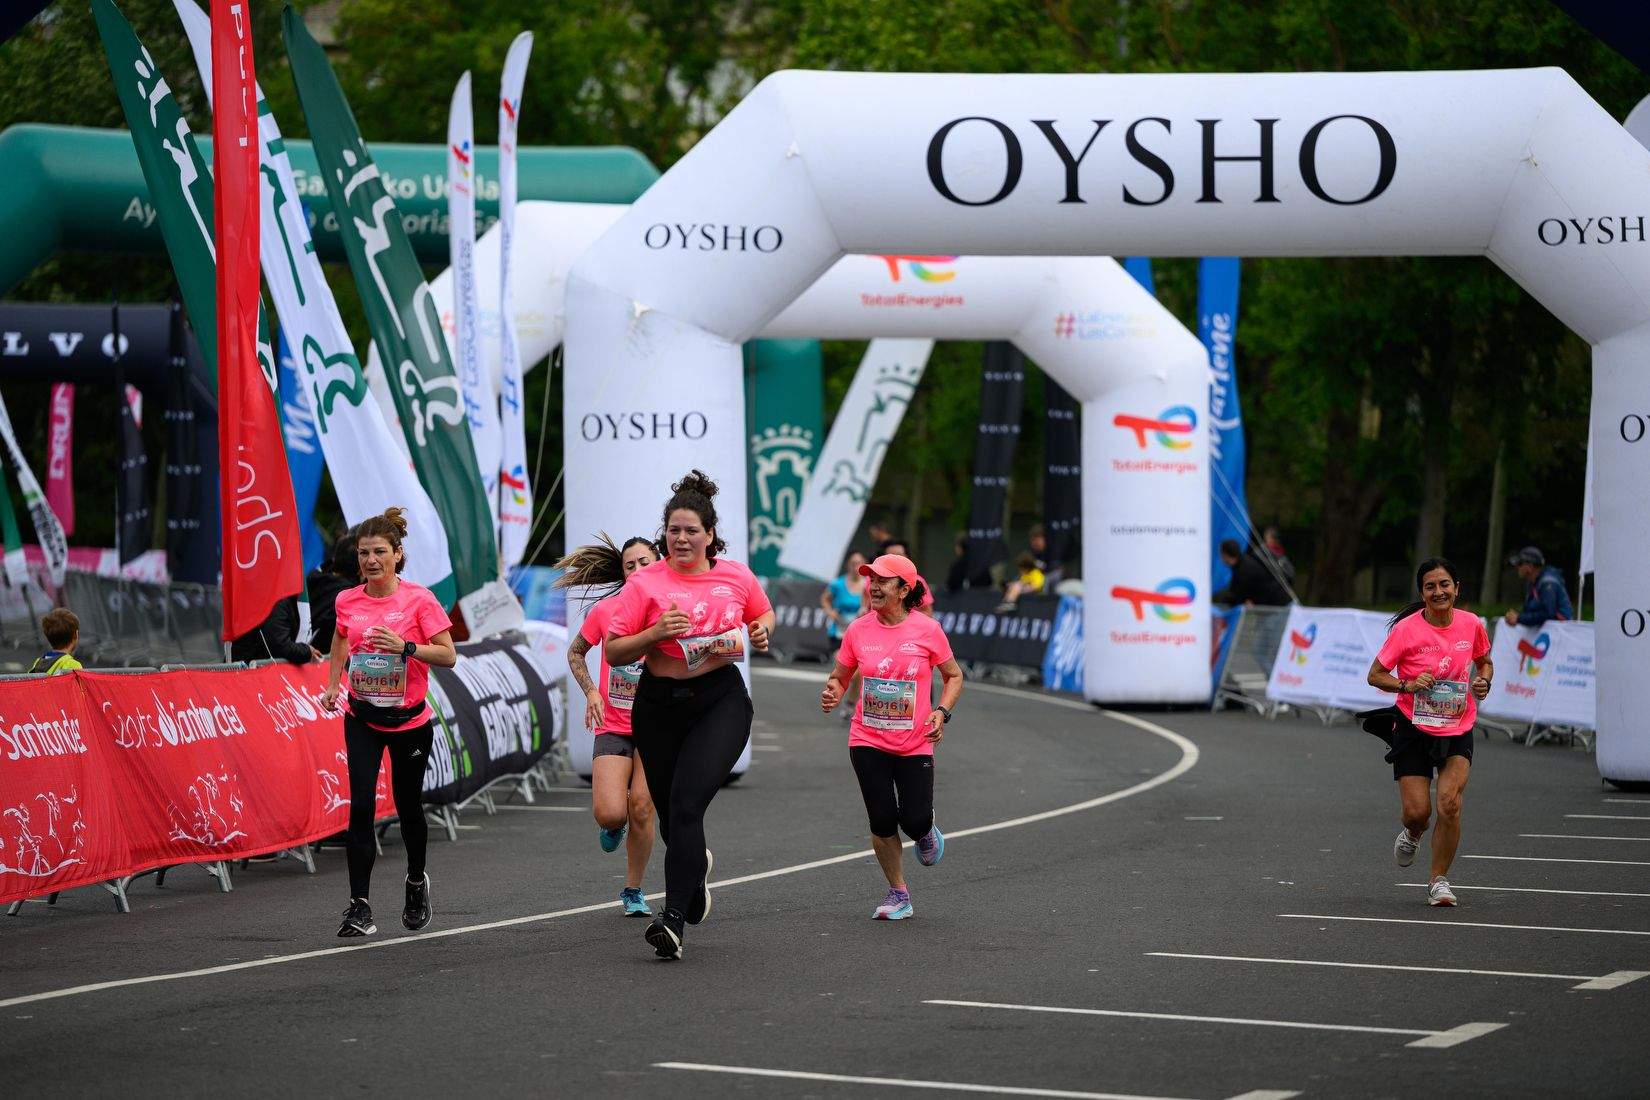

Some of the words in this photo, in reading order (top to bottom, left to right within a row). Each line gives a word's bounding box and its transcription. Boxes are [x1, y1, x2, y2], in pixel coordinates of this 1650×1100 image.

[926, 114, 1397, 206] OYSHO
[645, 223, 784, 252] OYSHO
[581, 412, 708, 442] OYSHO
[1112, 459, 1197, 474] TotalEnergies
